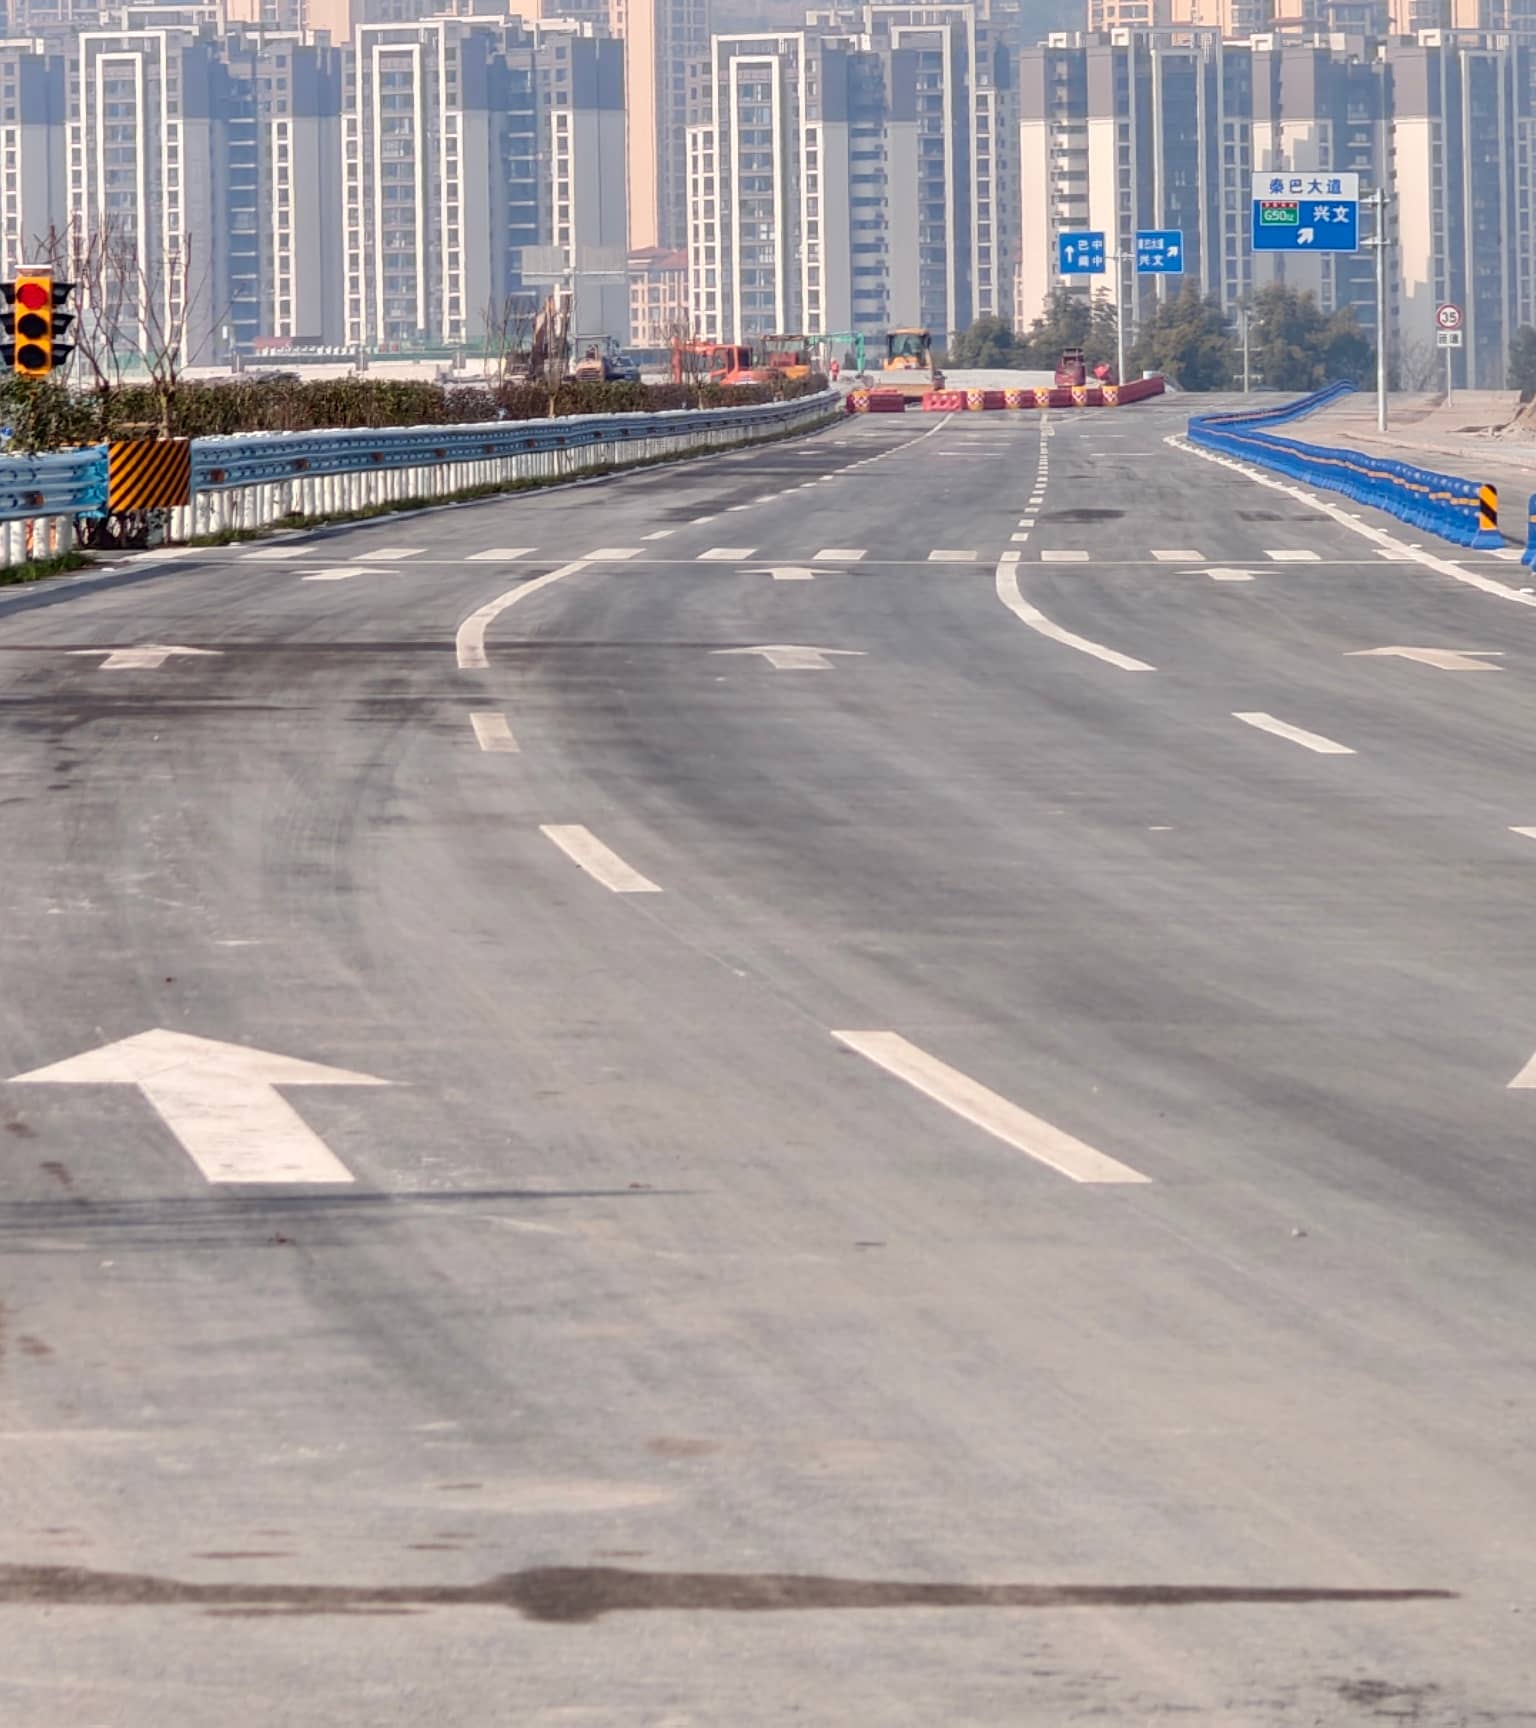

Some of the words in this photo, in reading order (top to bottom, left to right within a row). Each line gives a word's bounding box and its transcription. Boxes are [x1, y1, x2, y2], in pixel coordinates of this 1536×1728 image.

[1269, 178, 1342, 194] 秦巴大道
[1313, 205, 1350, 223] 兴文
[1442, 311, 1457, 323] 35
